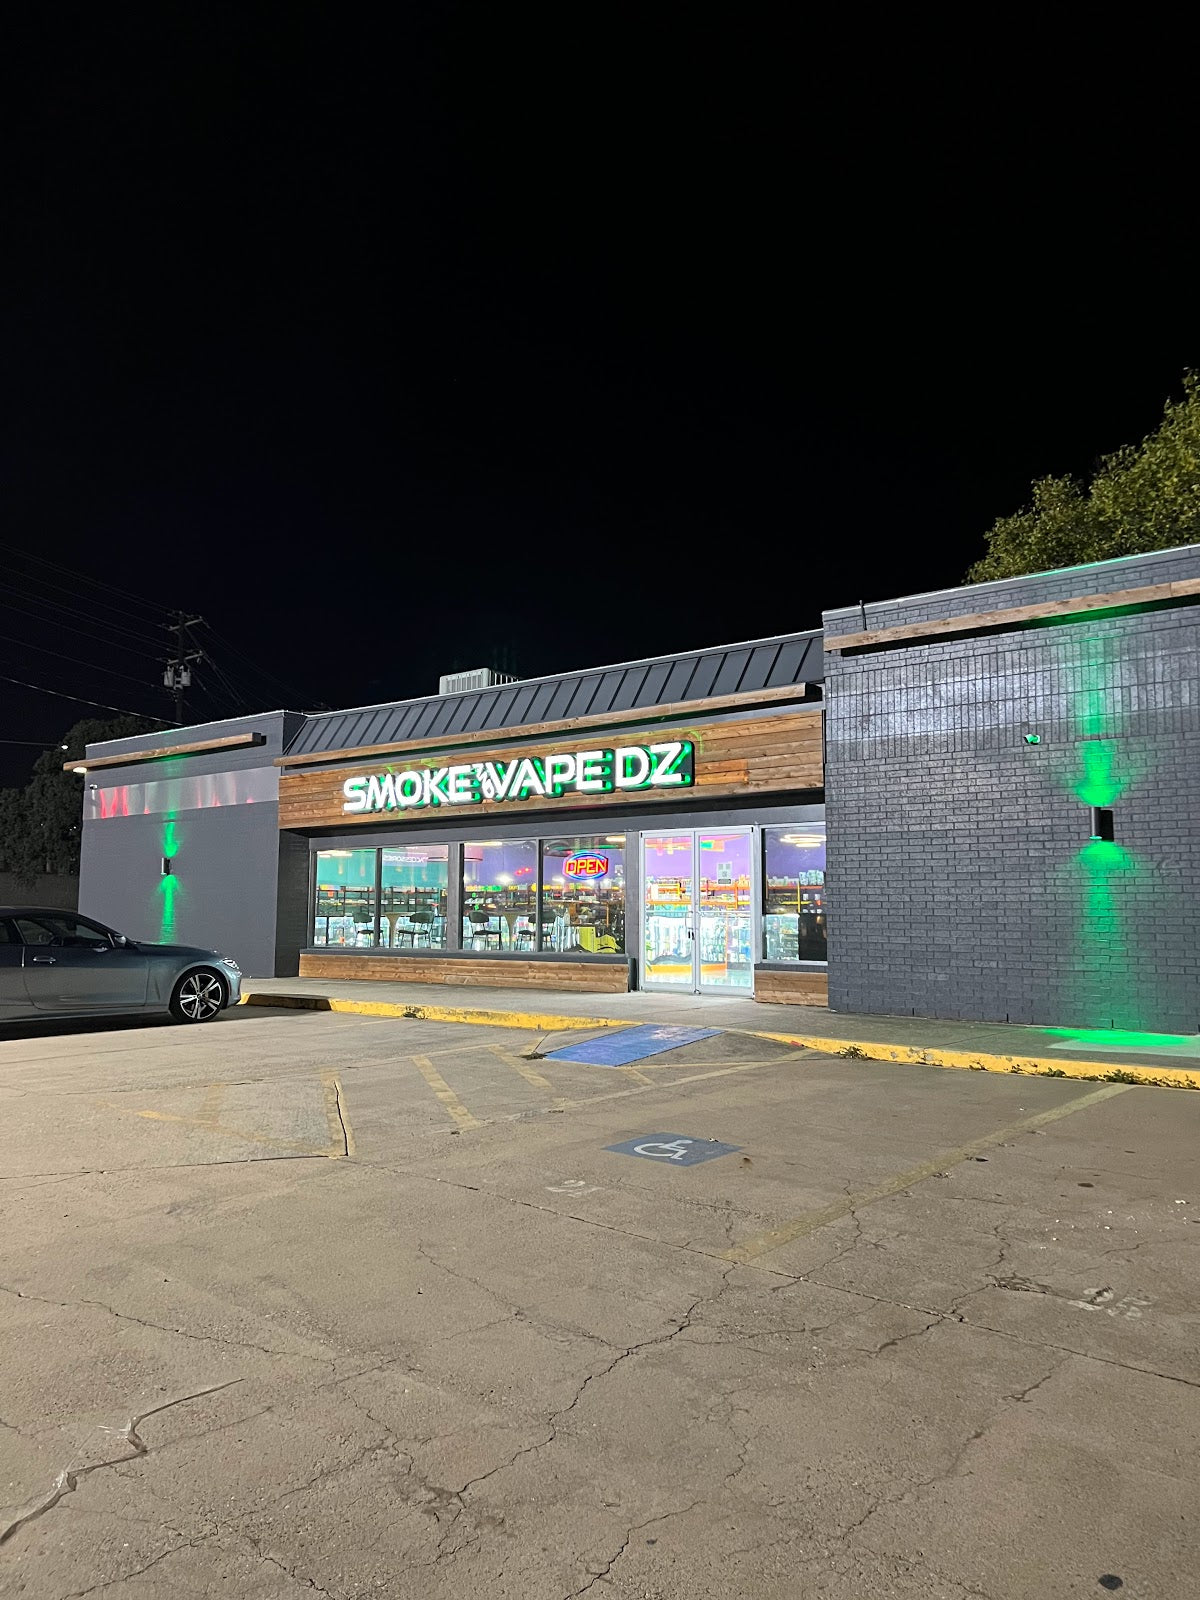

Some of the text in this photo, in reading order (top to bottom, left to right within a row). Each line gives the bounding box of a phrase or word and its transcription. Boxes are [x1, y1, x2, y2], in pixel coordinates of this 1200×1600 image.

[343, 763, 475, 811] SMOKE
[484, 749, 605, 800] VAPE
[615, 742, 685, 788] DZ
[565, 858, 607, 875] OPEN
